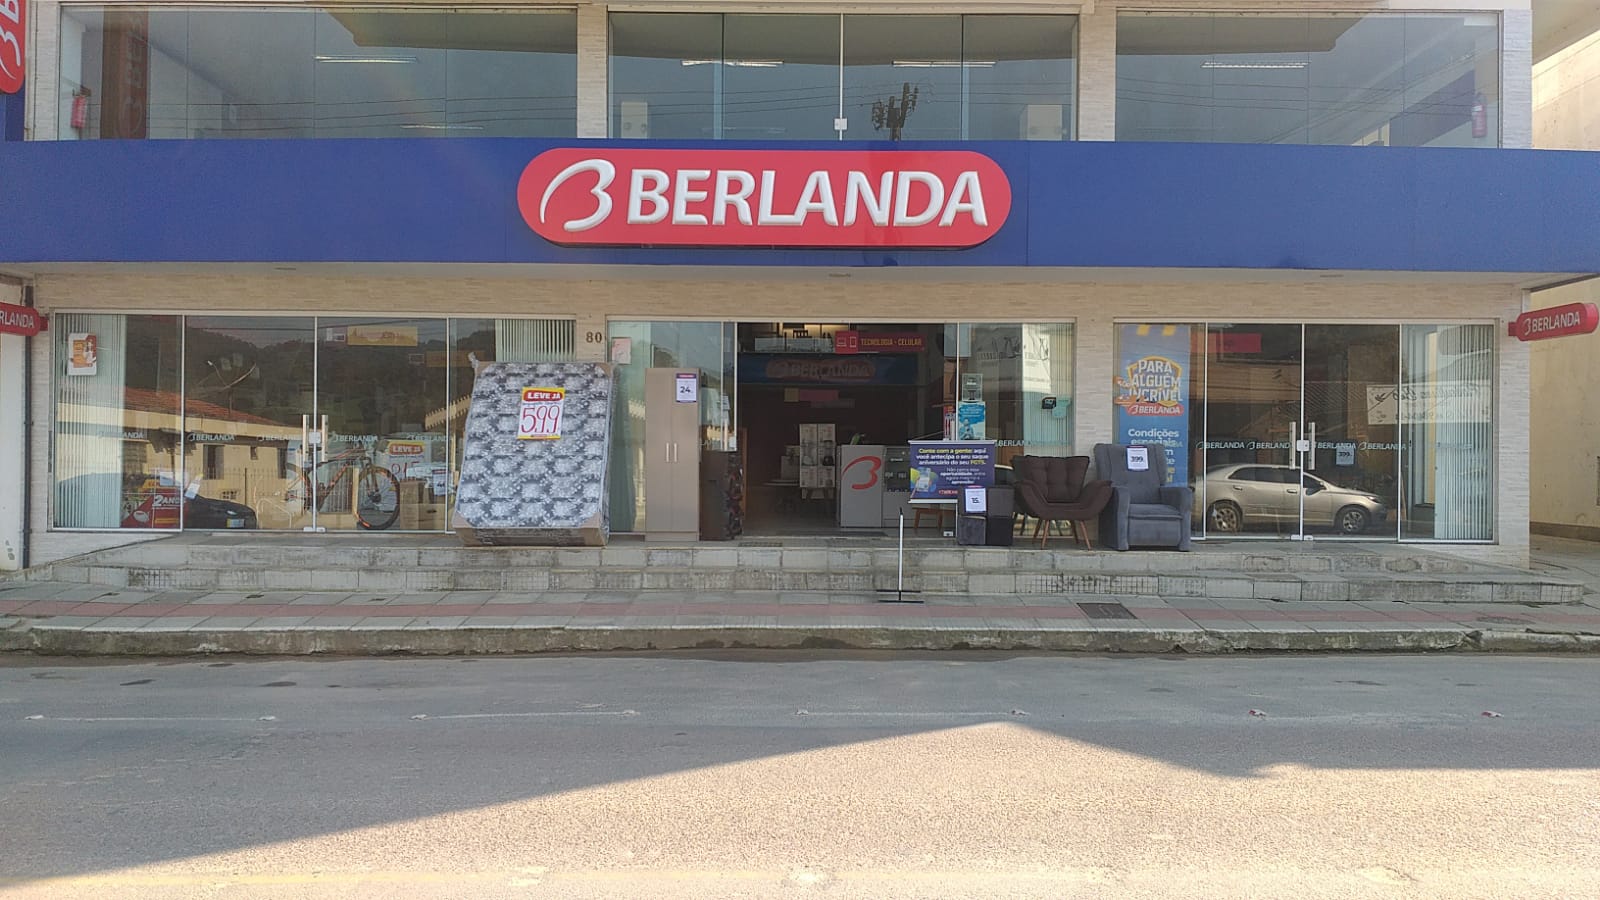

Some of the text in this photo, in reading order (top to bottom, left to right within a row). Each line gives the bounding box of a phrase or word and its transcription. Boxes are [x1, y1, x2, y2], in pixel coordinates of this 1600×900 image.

[627, 168, 988, 228] BERLANDA
[1532, 311, 1581, 333] BERLANDA
[586, 331, 602, 343] 80
[1138, 360, 1173, 374] PARA
[1132, 373, 1181, 389] ALGUÉM
[527, 391, 552, 399] LEVE
[1139, 404, 1181, 415] BERLANDA
[521, 405, 560, 433] 599
[195, 433, 236, 441] BERLANDA
[339, 434, 379, 442] BERLANDA
[1127, 428, 1180, 439] Condições
[1206, 441, 1245, 449] BERLANDA
